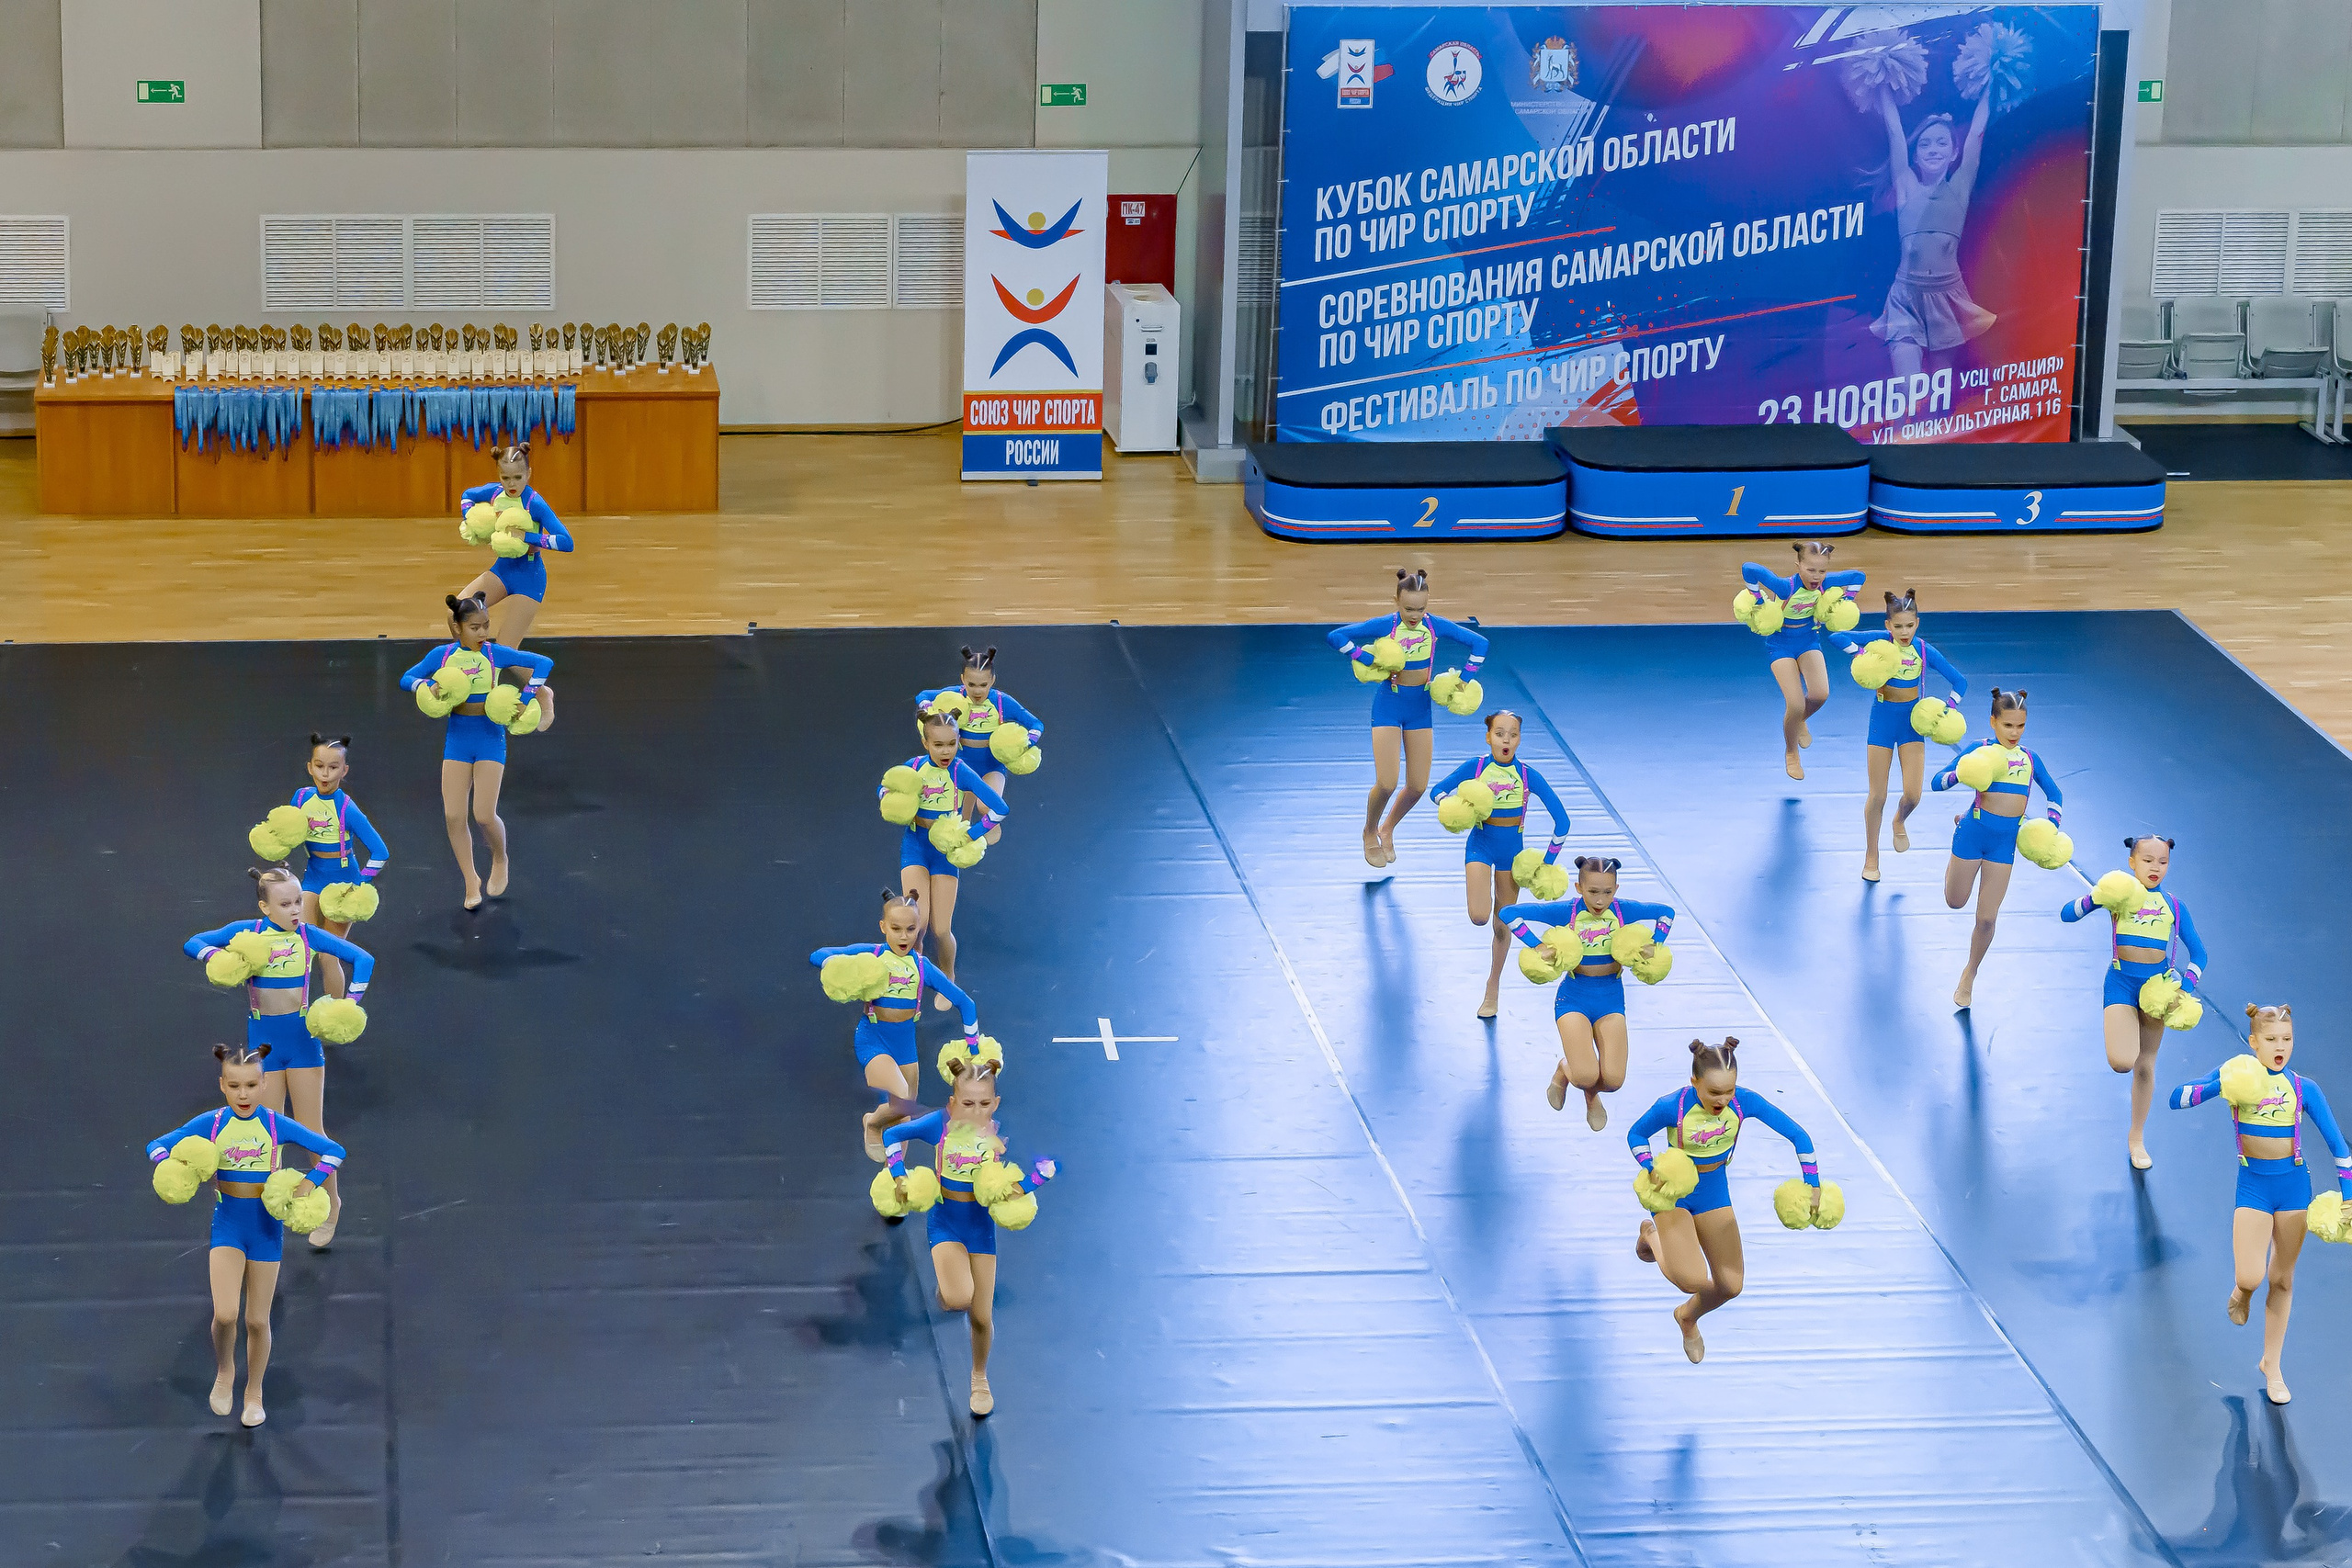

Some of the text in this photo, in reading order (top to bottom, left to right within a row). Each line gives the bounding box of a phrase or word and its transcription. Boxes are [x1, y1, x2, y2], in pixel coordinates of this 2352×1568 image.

[1316, 117, 1736, 221] КУБОК САМАРСКОЙ ОБЛАСТИ
[1315, 191, 1535, 262] ПО ЧИР СПОРТУ
[1318, 203, 1864, 329] СОРЕВНОВАНИЯ САМАРСКОЙ ОБЛАСТИ
[1318, 298, 1539, 368] ПО ЧИР СПОРТУ
[1321, 334, 1725, 435] ФЕСТИВАЛЬ ПО ЧИР СПОРТУ
[1960, 355, 2064, 389] УСЦ «ГРАЦИЯ»
[1984, 377, 2062, 406] Г. САМАРА,
[970, 399, 1096, 425] СОЮЗ ЧИР СПОРТА
[1758, 368, 1953, 429] 23 НОЯБРЯ
[1871, 398, 2061, 445] УЛ. ФИЗКУЛЬТУРНАЯ, 116
[1005, 439, 1059, 466] РОССИИ
[1411, 496, 1439, 528] 2
[1723, 486, 1746, 516] 1
[2016, 491, 2042, 525] 3
